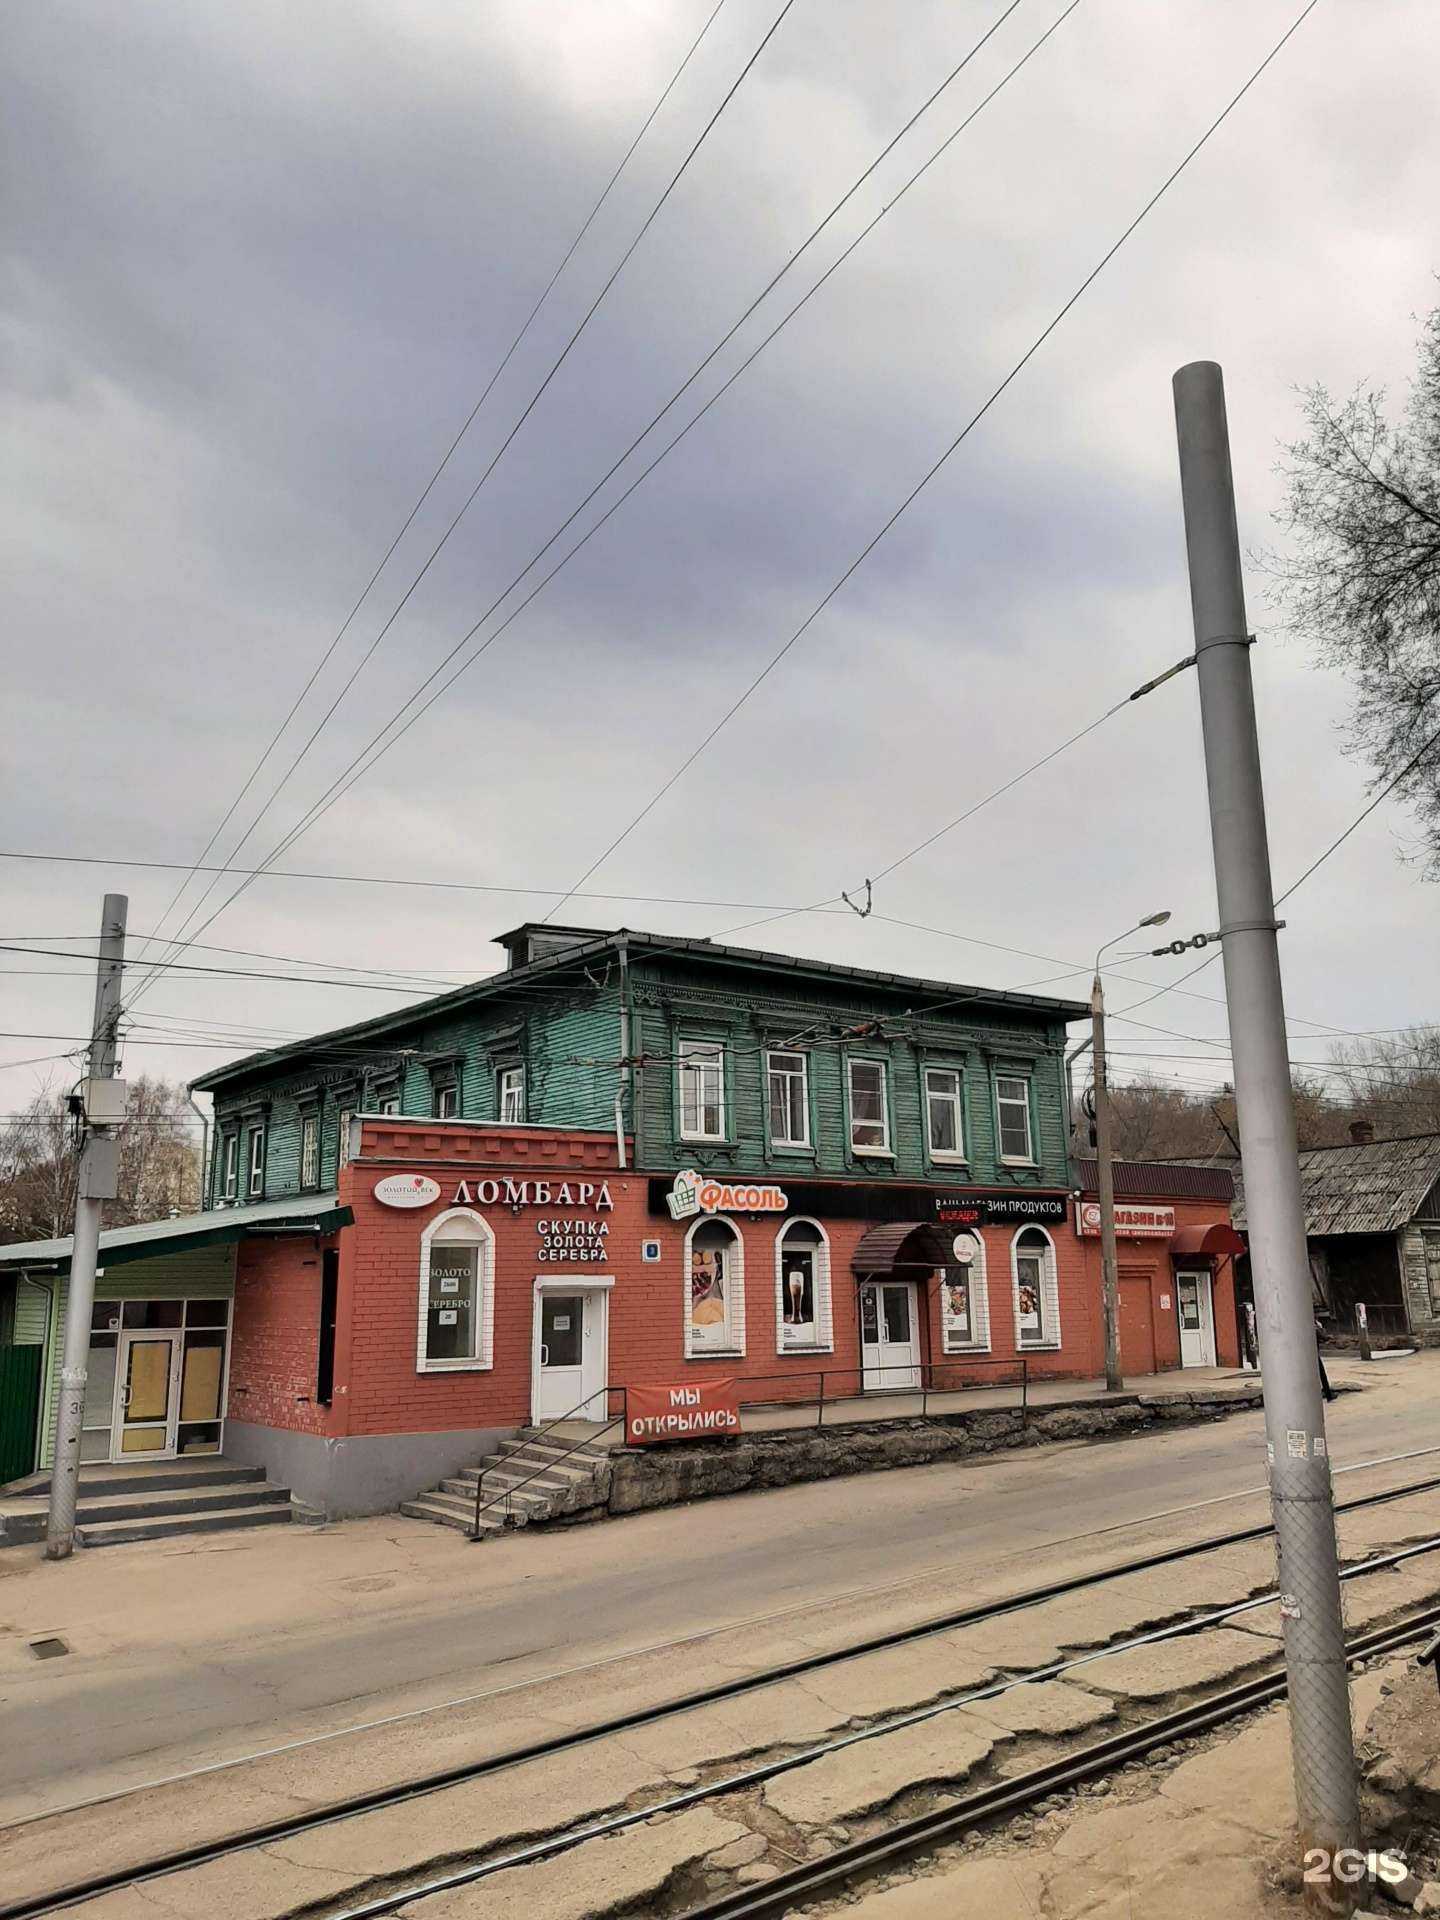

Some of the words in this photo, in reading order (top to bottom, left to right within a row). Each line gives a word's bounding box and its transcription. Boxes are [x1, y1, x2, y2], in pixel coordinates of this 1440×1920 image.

[452, 1180, 614, 1211] ЛОМБАРД
[700, 1184, 786, 1210] ФАСОЛЬ
[1009, 1201, 1063, 1214] ПРОДУКТОВ
[537, 1220, 610, 1235] СКУПКА
[544, 1236, 604, 1248] ЗОЛОТА
[538, 1249, 609, 1262] СЕРЕБРА
[669, 1388, 701, 1407] МЫ
[631, 1409, 737, 1436] ОТКРЫЛИСЬ
